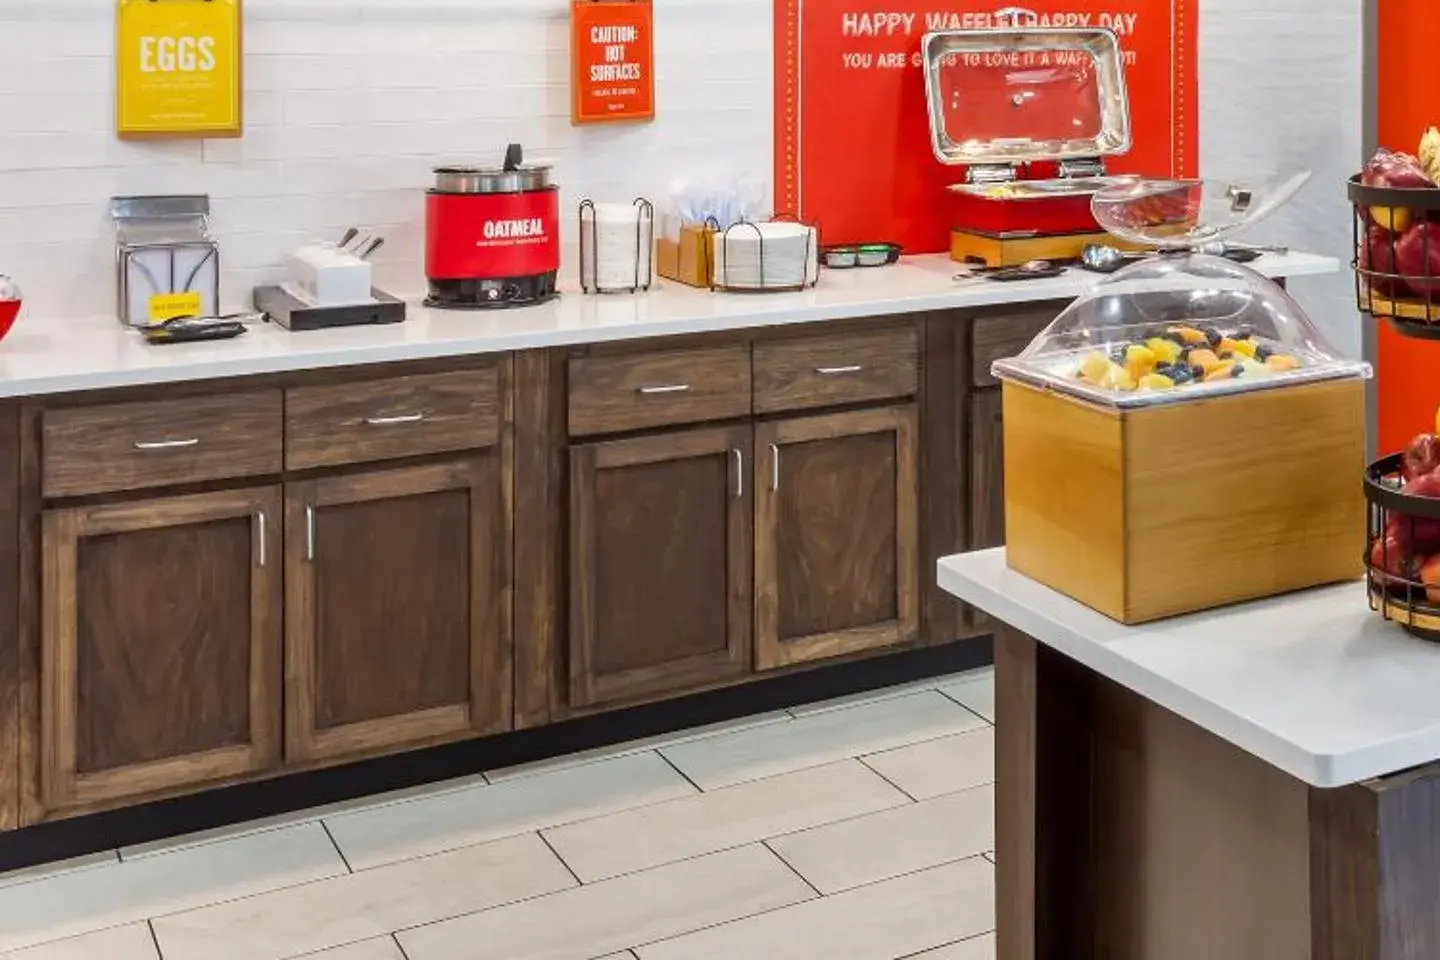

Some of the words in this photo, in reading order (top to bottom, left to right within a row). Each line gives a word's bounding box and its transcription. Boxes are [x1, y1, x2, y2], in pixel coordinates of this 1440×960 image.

[842, 12, 915, 37] HAPPY
[1099, 13, 1138, 36] DAY
[140, 36, 216, 72] EGGS
[842, 53, 872, 69] YOU
[877, 53, 906, 68] ARE
[985, 51, 1019, 67] LOVE
[1040, 51, 1050, 66] A
[483, 218, 544, 239] OATMEAL
